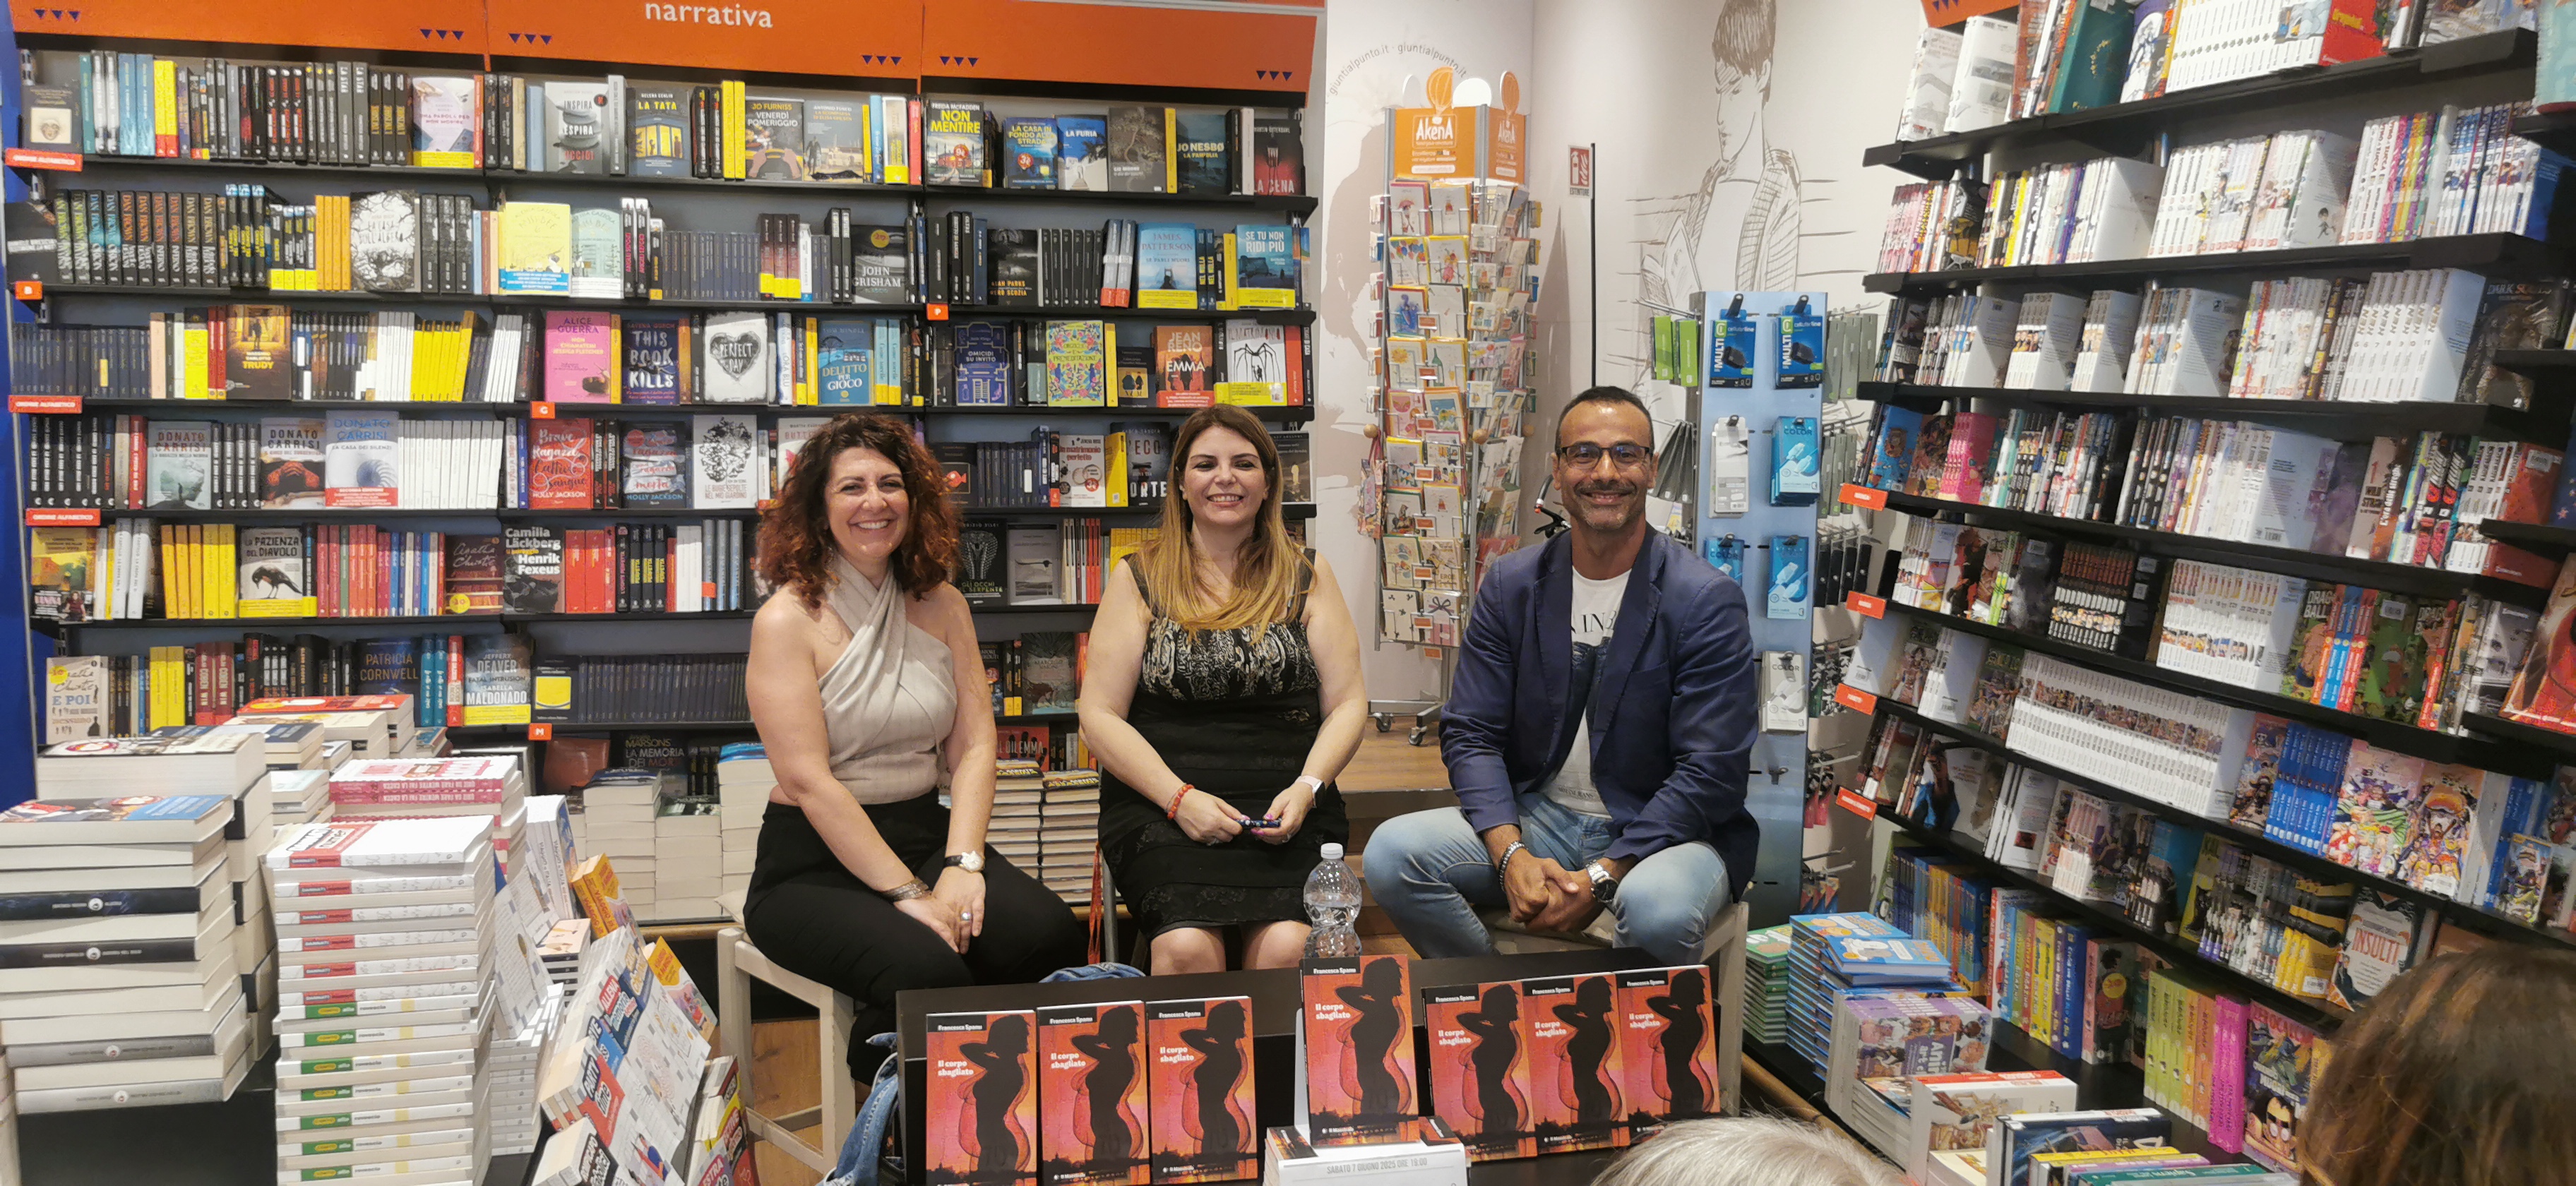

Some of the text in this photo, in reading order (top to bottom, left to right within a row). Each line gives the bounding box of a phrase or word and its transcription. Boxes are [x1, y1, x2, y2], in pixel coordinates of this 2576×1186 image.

[645, 3, 773, 28] narrativa
[1397, 42, 1467, 78] giuntialpunto.it
[1329, 44, 1390, 96] giuntialpunto.it
[564, 100, 592, 109] INSPIRA
[638, 102, 677, 110] LA TATA
[757, 111, 789, 119] VENERDÌ
[941, 110, 970, 121] NON
[747, 119, 798, 128] POMERIGGIO
[931, 121, 980, 134] MENTIRE
[1416, 117, 1453, 140] AkenA
[1177, 142, 1224, 152] JO NESBØ
[1269, 179, 1294, 193] CENA
[1569, 187, 1590, 197] ESTINTORE
[1246, 231, 1284, 241] SE TU NON
[1246, 239, 1285, 253] RIDI PIÙ
[862, 266, 890, 277] JOHN
[852, 277, 901, 288] GRISHAM
[558, 325, 599, 334] GUERRA
[633, 330, 668, 347] THIS
[1171, 332, 1200, 342] JEAN
[720, 342, 753, 358] PERFECT
[1167, 341, 1203, 352] RENO
[1782, 335, 1792, 366] MULTI
[629, 347, 674, 366] BOOK
[1715, 338, 1724, 369] MULTI
[243, 361, 274, 369] TRUDY
[728, 357, 744, 373] DAY
[1167, 361, 1205, 372] EMMA
[823, 364, 867, 377] DELITTO
[628, 371, 675, 388] KILLS
[827, 379, 862, 390] GIOCO
[335, 419, 389, 429] DONATO
[158, 432, 205, 442] DONATO
[270, 429, 318, 439] DONATO
[337, 431, 387, 440] CARRISI
[539, 429, 574, 443] Brave
[155, 443, 206, 452] CARRISI
[268, 439, 320, 448] CARRISI
[1130, 481, 1168, 498] ORTE
[506, 528, 550, 537] Camilla
[254, 537, 299, 547] PAZIENZA
[506, 538, 561, 551] Läckberg
[259, 547, 297, 556] DIAVOLO
[518, 554, 560, 564] Henrik
[518, 565, 560, 575] Fexeus
[2303, 604, 2328, 618] BALL
[366, 654, 413, 665] PATRICIA
[477, 659, 517, 673] DEAVER
[360, 669, 418, 681] CORNWELL
[52, 694, 90, 705] E POI
[467, 691, 527, 705] MALDONADO
[626, 738, 671, 748] MARSONS
[626, 748, 684, 757] LA MEMORIA
[628, 758, 646, 767] DEI
[2352, 928, 2401, 962] INSULTI
[600, 976, 619, 1010] ALLENA
[1325, 1003, 1344, 1013] corpo
[1316, 1011, 1351, 1022] sbagliato
[1636, 1012, 1654, 1022] corpo
[1542, 1021, 1560, 1029] corpo
[1629, 1019, 1660, 1029] sbagliato
[1445, 1029, 1465, 1038] corpo
[1535, 1027, 1566, 1037] sbagliato
[1438, 1036, 1471, 1046] sbagliato
[1167, 1047, 1188, 1055] corpo
[1058, 1053, 1079, 1062] corpo
[1160, 1053, 1194, 1063] sbagliato
[946, 1061, 967, 1070] corpo
[1051, 1060, 1086, 1070] sbagliato
[938, 1068, 974, 1078] sbagliato
[1327, 1166, 1350, 1174] SABATO
[1357, 1163, 1379, 1172] GIUGNO
[1381, 1161, 1396, 1170] 2025
